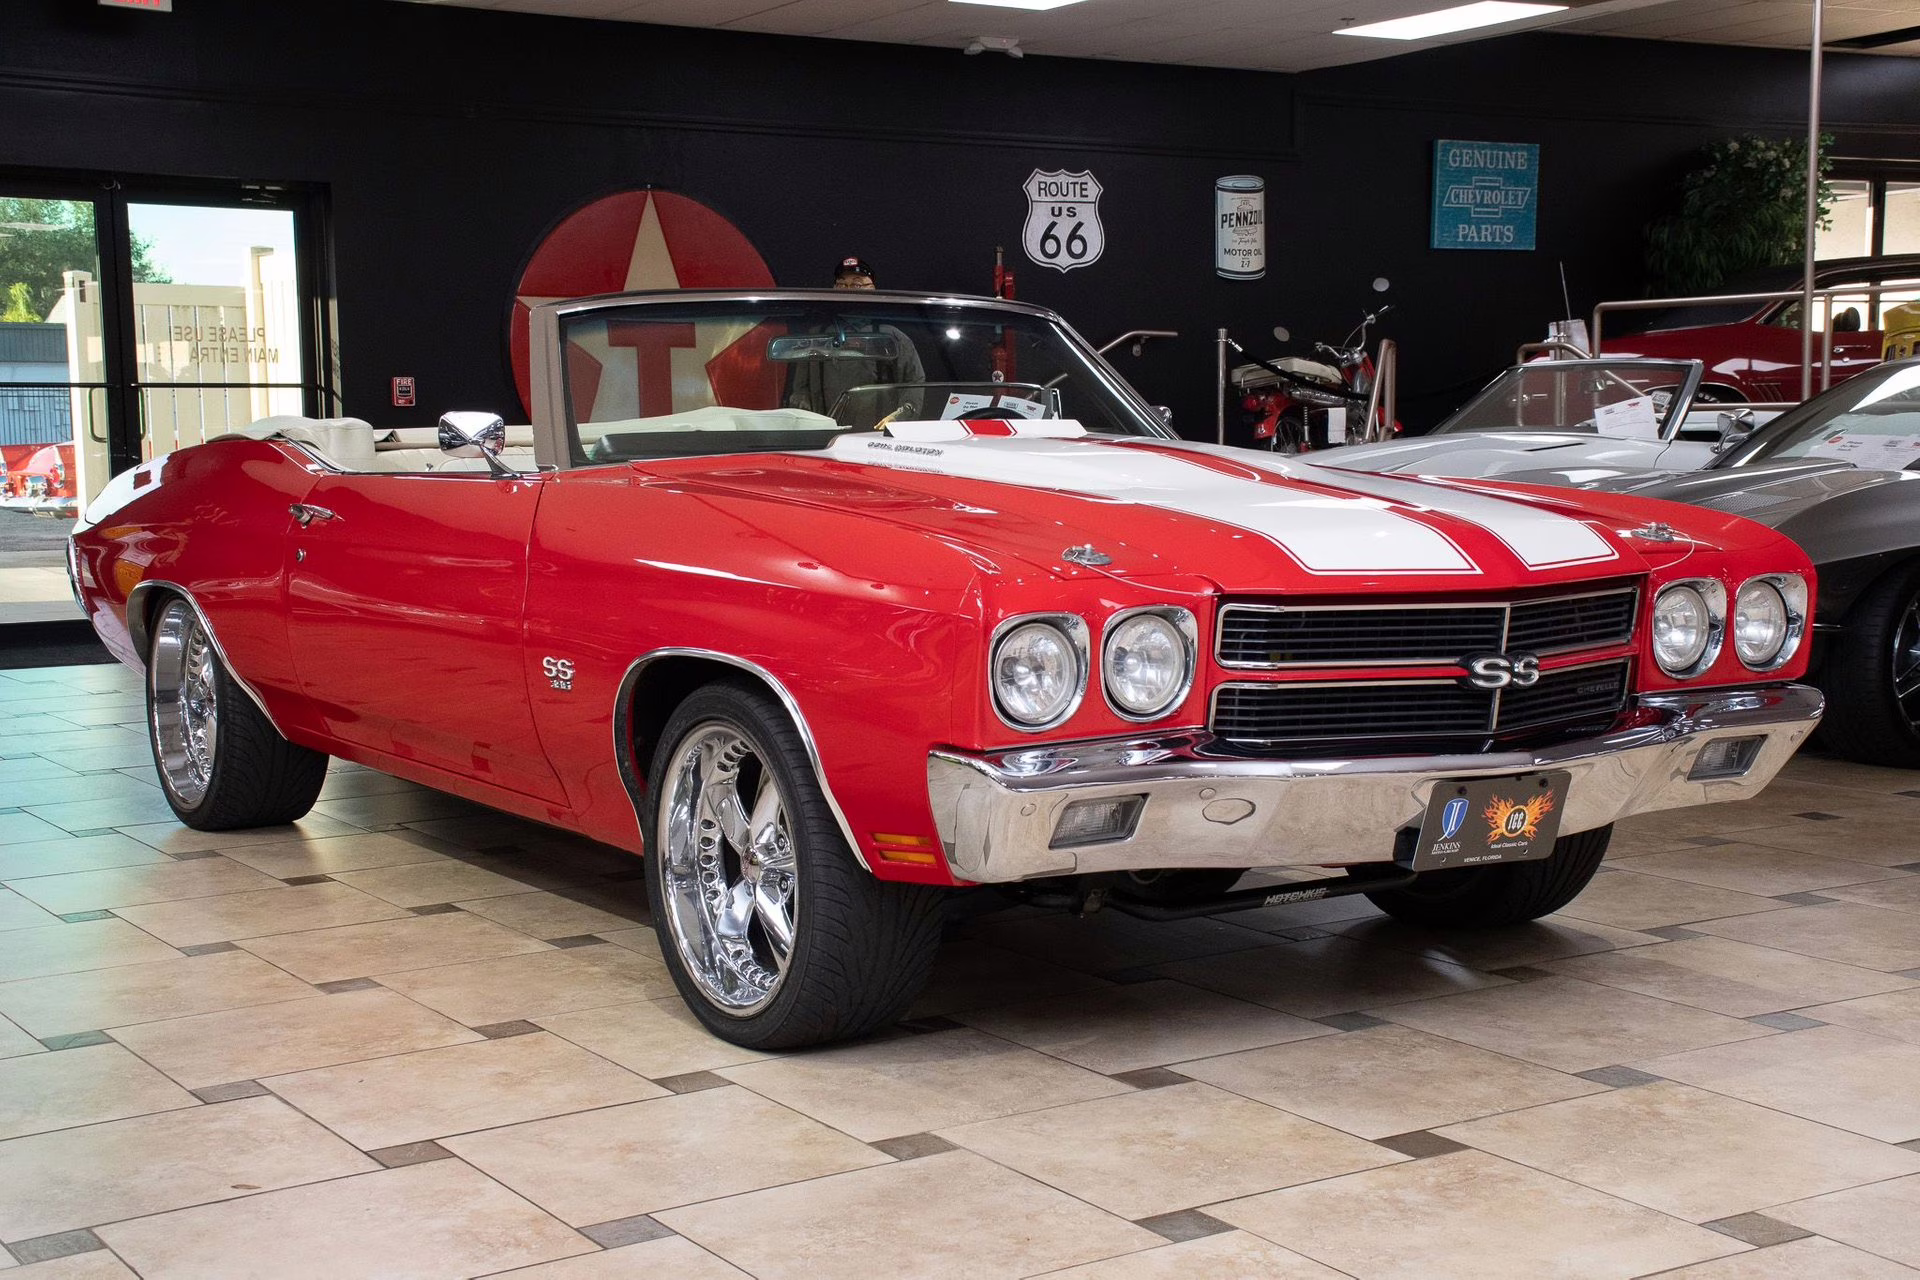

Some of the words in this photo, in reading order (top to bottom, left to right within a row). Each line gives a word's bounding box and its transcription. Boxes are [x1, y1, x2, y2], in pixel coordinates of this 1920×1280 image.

[1448, 149, 1528, 170] GENUINE
[1037, 181, 1089, 198] ROUTE
[1451, 188, 1525, 206] CHEVROLET
[1050, 206, 1077, 217] US
[1039, 220, 1088, 260] 66
[1457, 224, 1514, 243] PARTS
[1223, 248, 1253, 257] MOTOR
[396, 378, 413, 386] FIRE
[543, 655, 575, 680] SS
[1471, 656, 1540, 689] SS
